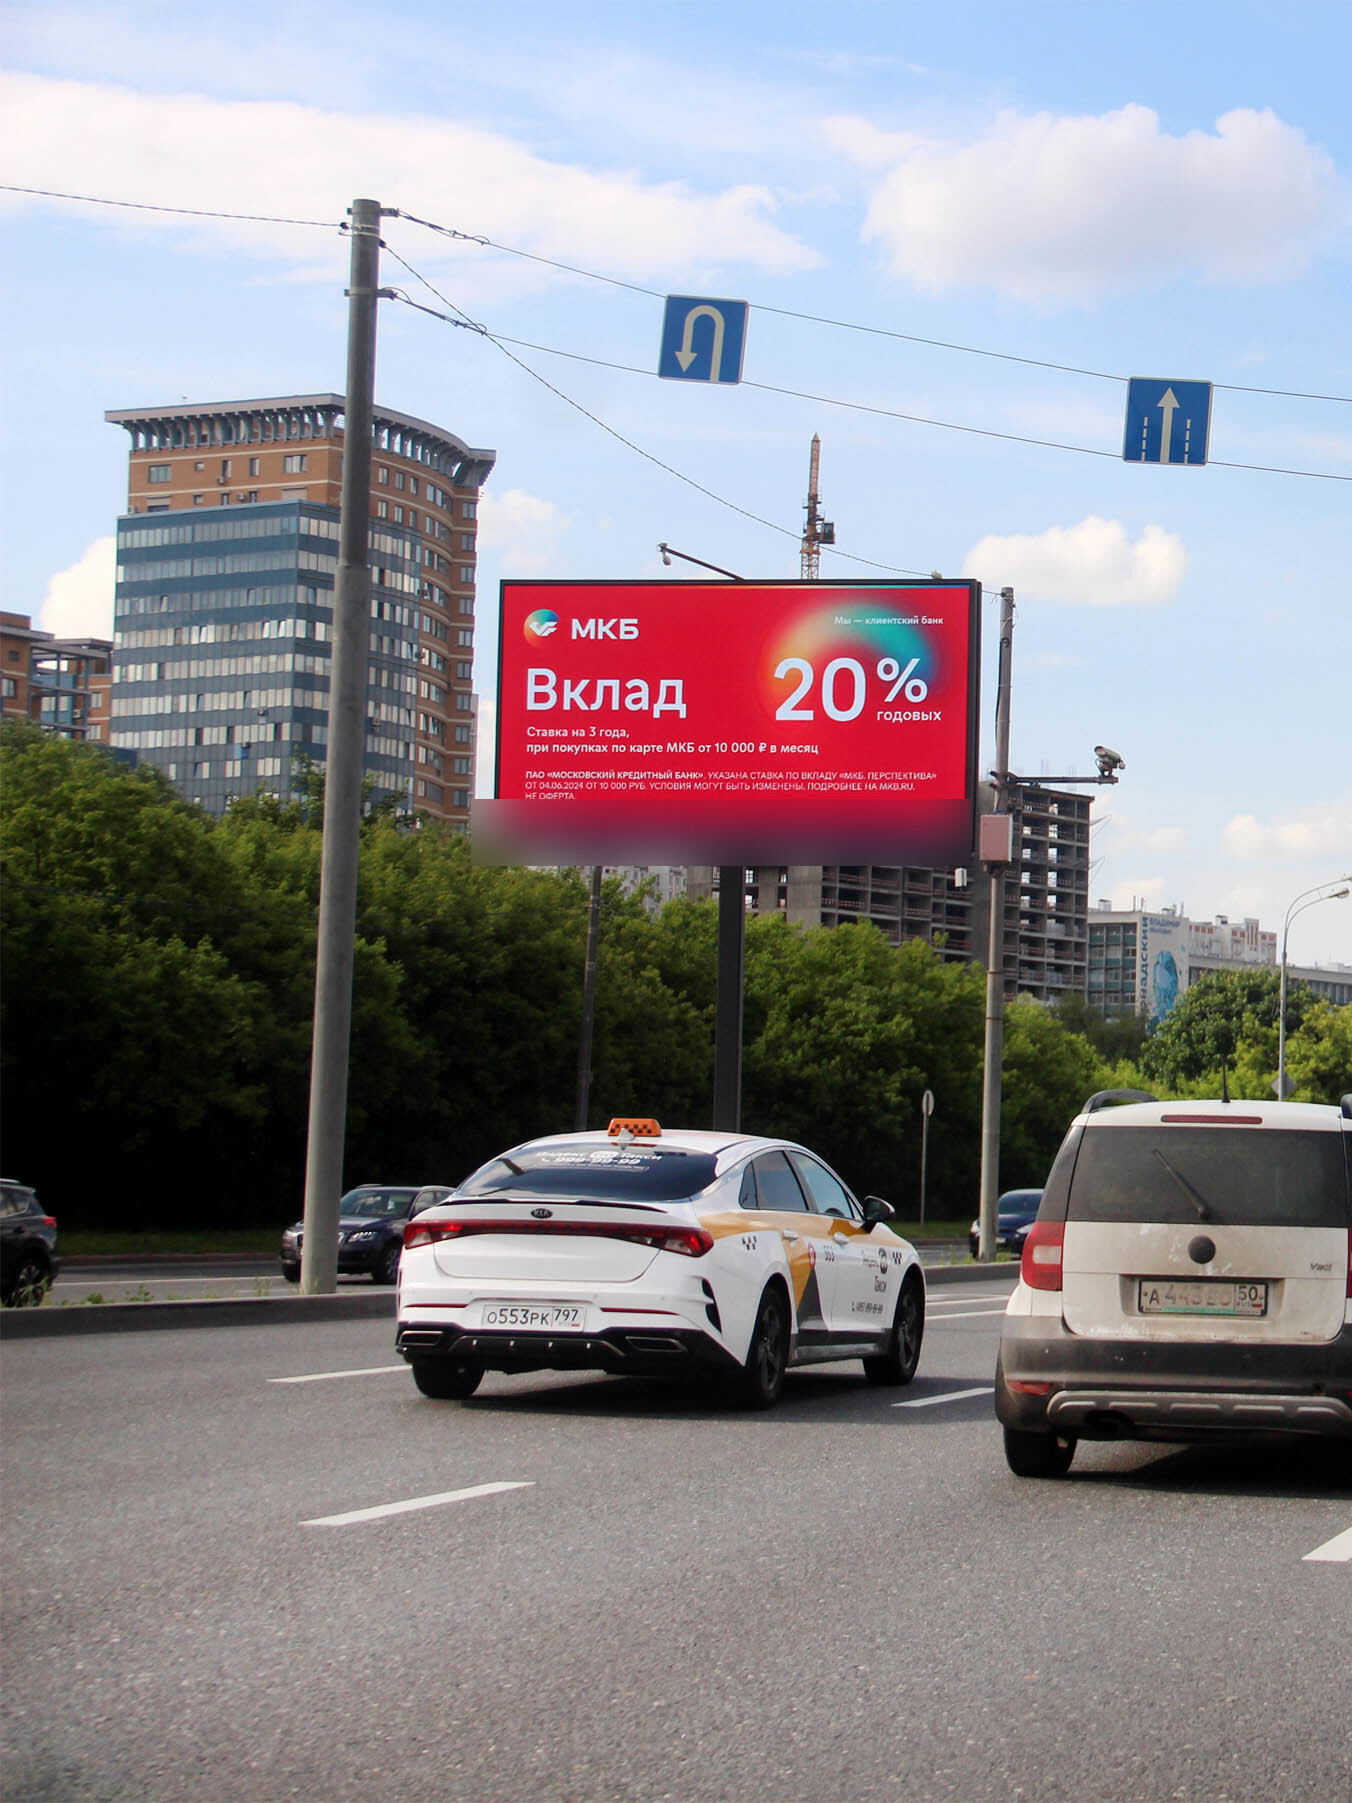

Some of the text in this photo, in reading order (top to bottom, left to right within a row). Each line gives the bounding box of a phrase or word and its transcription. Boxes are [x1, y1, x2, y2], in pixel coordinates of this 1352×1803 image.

[834, 616, 852, 625] Мы
[865, 615, 919, 625] клиентский
[921, 615, 944, 625] банк
[571, 618, 640, 640] МКБ
[527, 668, 687, 719] Вклад
[877, 711, 942, 723] годовых
[527, 726, 630, 739] Ставка на 3 года,
[526, 742, 819, 756] при покупках по карте МКБ от 10 000 ₽ в месяц
[526, 771, 545, 779] ПАО
[548, 770, 615, 780] «МОСКОВСКИЙ
[617, 770, 672, 780] КРЕДИТНЫЙ
[708, 772, 748, 780] УКАЗАНА
[750, 772, 783, 780] СТАВКА
[786, 772, 799, 780] ПО
[802, 772, 837, 781] ВКЛАДУ
[868, 772, 936, 781] ПЕРСПЕКТИВА»
[525, 782, 537, 790] ОТ
[586, 782, 597, 790] ОТ
[600, 782, 608, 790] 10
[611, 782, 626, 790] 000
[650, 782, 691, 790] УСЛОВИЯ
[808, 783, 862, 792] ПОДРОБНЕЕ
[865, 783, 877, 791] НА
[1237, 1286, 1258, 1301] 50
[554, 1309, 579, 1321] 797
